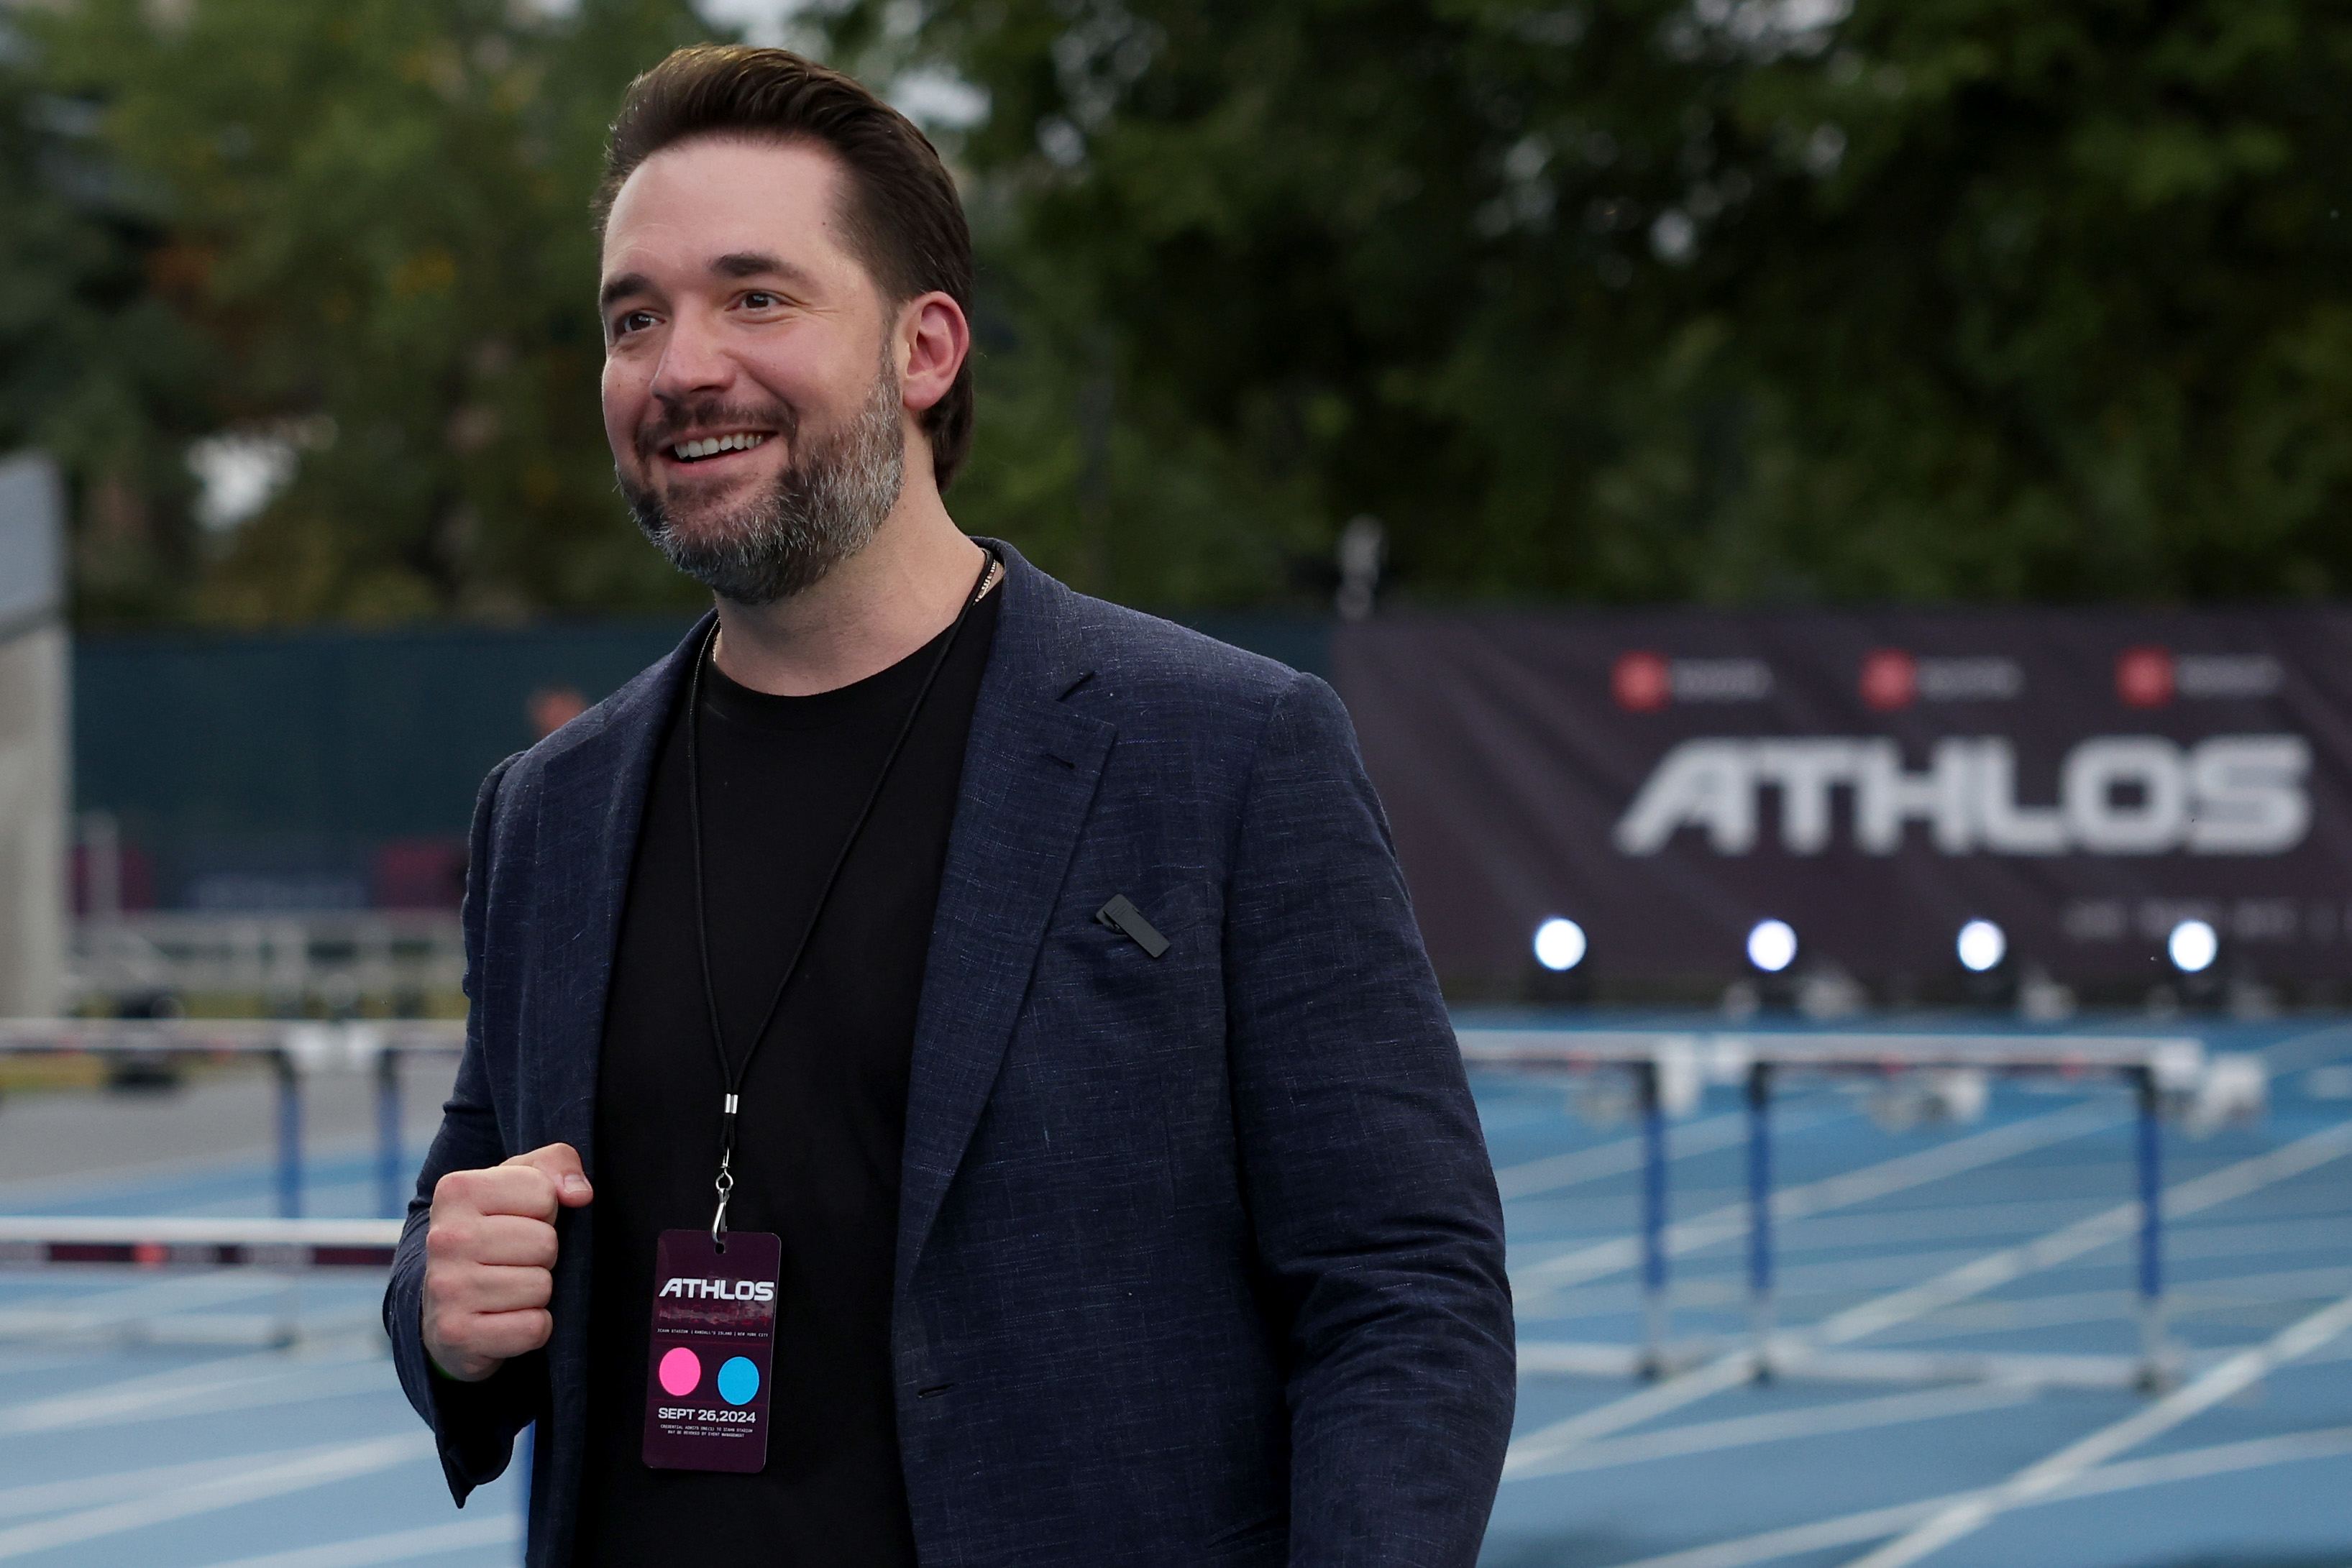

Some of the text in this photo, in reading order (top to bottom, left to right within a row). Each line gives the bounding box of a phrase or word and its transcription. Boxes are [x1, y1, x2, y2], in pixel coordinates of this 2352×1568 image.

[1614, 735, 2312, 856] ATHLOS
[659, 1278, 774, 1301] ATHLOS
[658, 1407, 756, 1423] SEPT 26,2024
